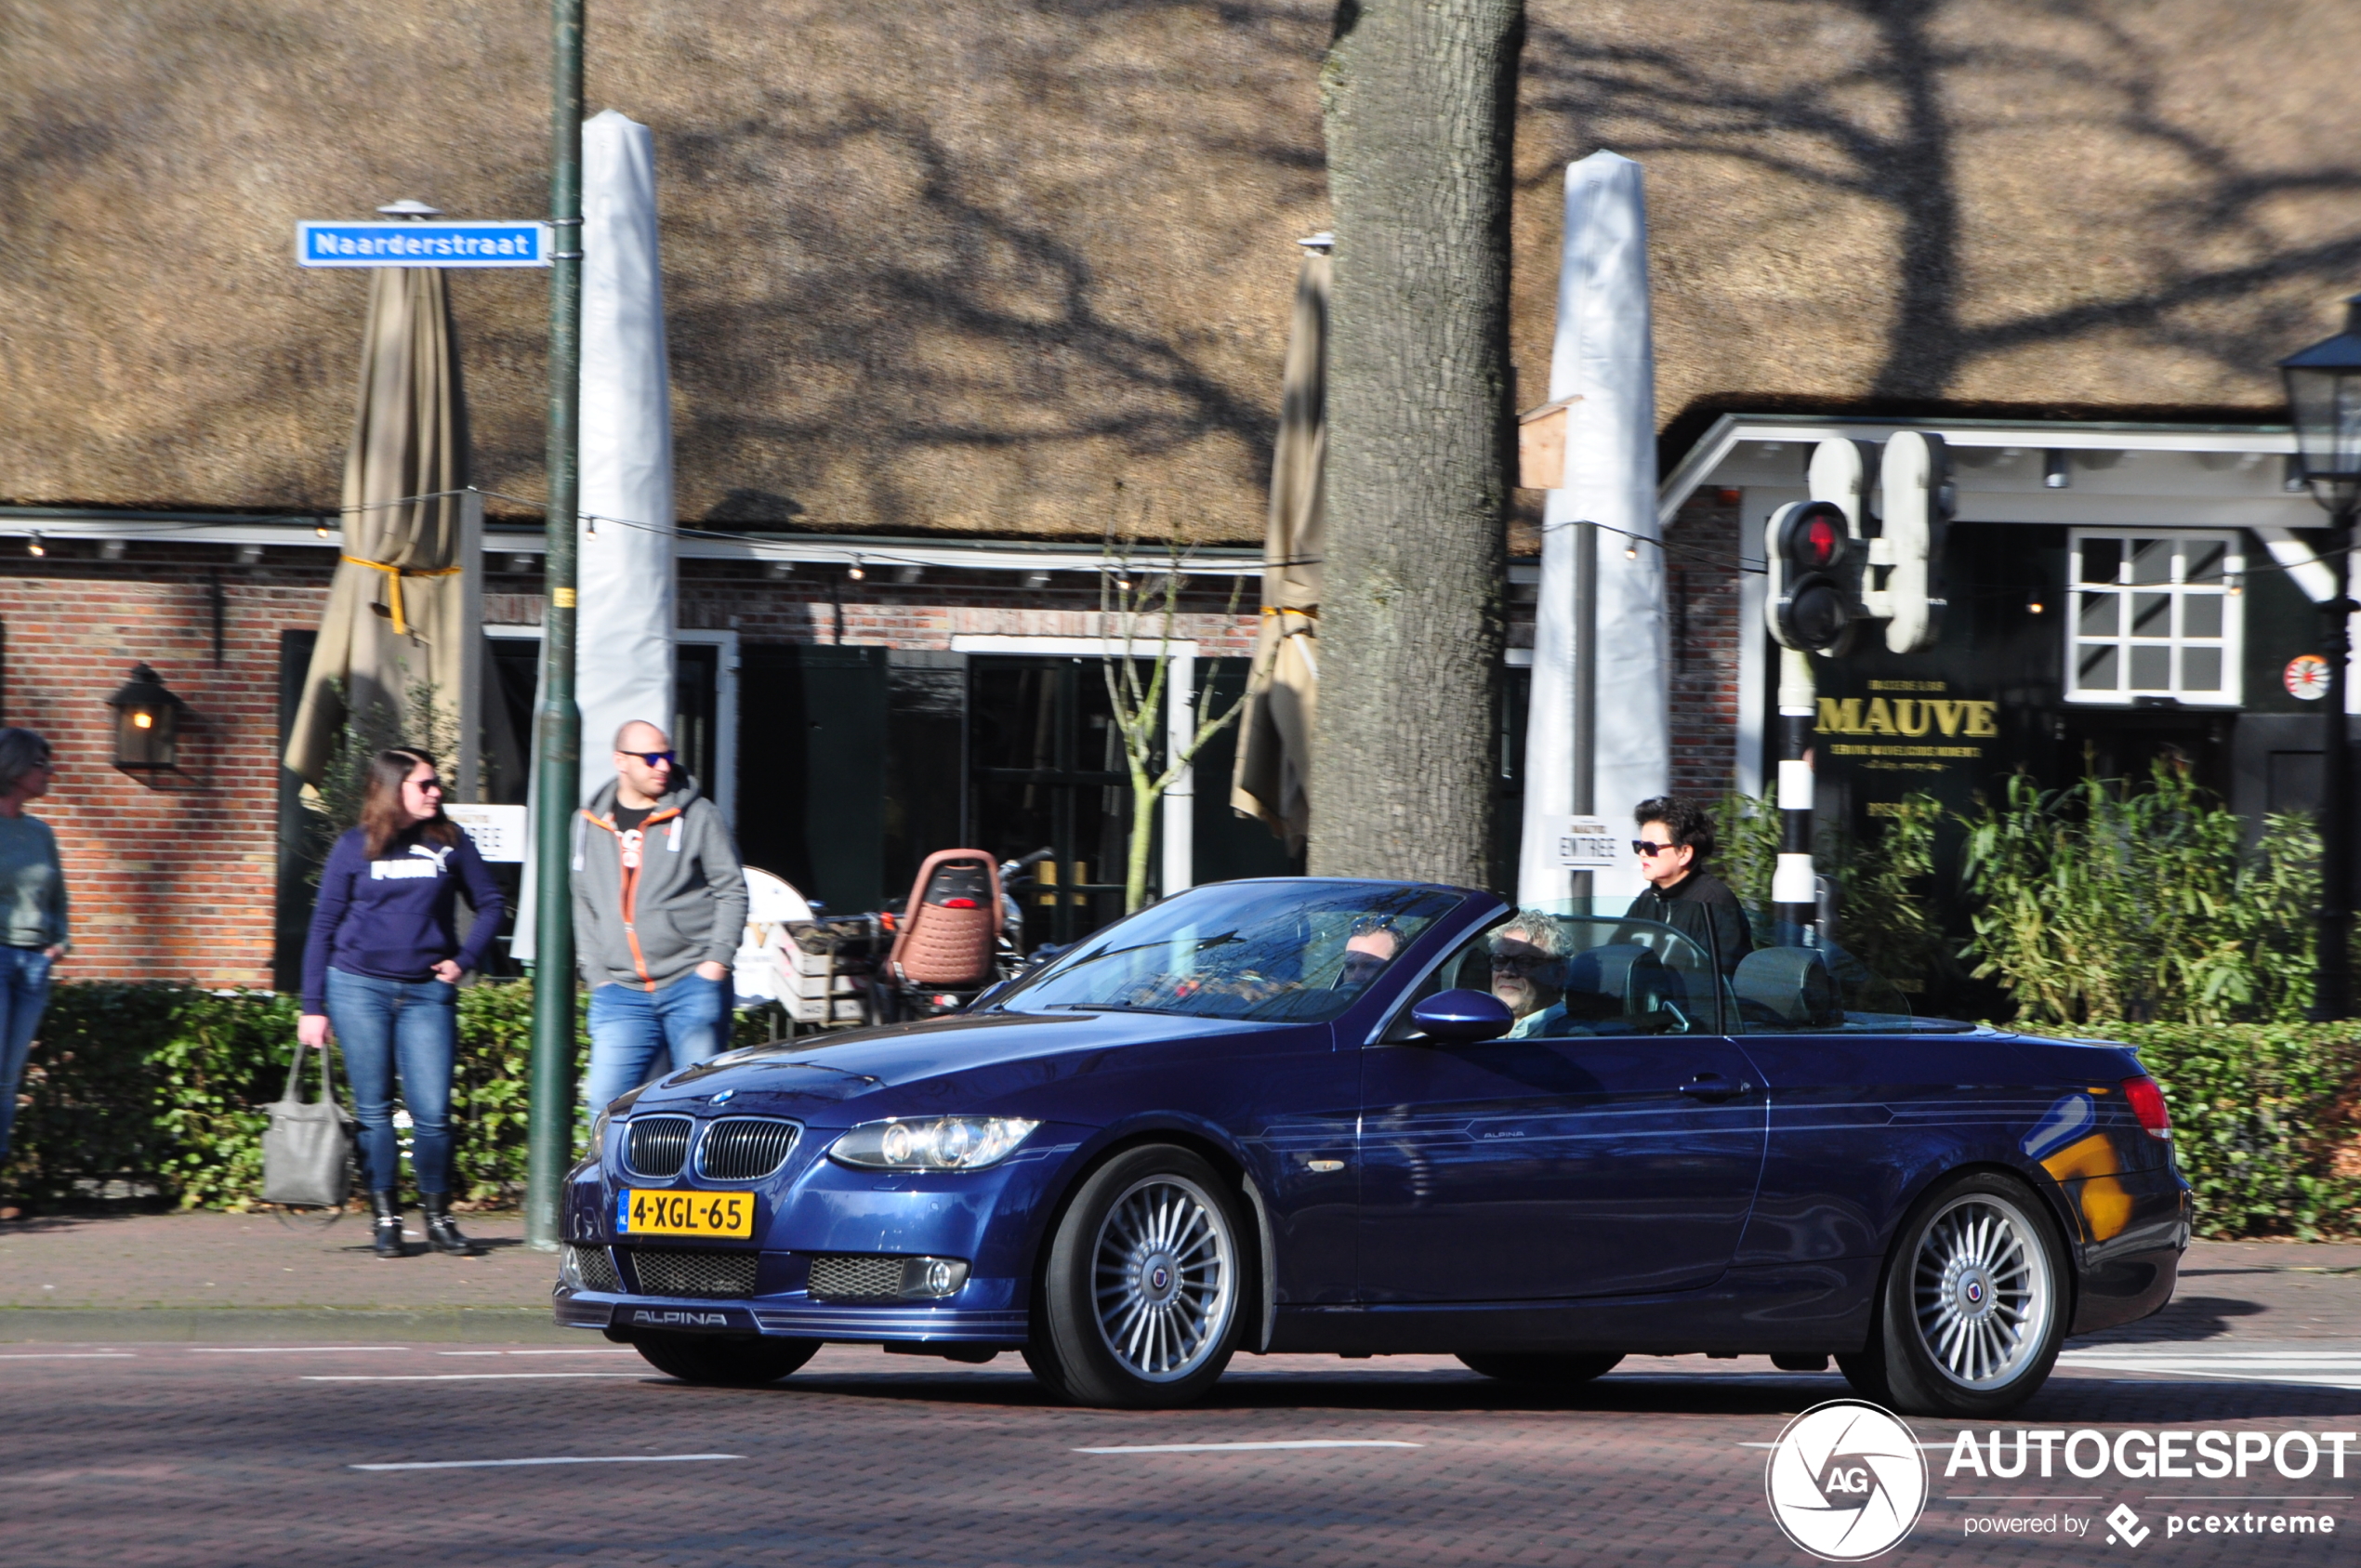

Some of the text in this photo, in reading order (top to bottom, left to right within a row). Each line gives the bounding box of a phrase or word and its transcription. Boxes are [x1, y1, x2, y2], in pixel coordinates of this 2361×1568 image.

[315, 232, 530, 256] Naarderstraat
[1814, 697, 1998, 738] MAUVE
[1484, 1130, 1525, 1139] ALPINA
[619, 1215, 627, 1224] NL
[633, 1196, 742, 1230] 4-XGL-65
[633, 1310, 728, 1325] ALPINA
